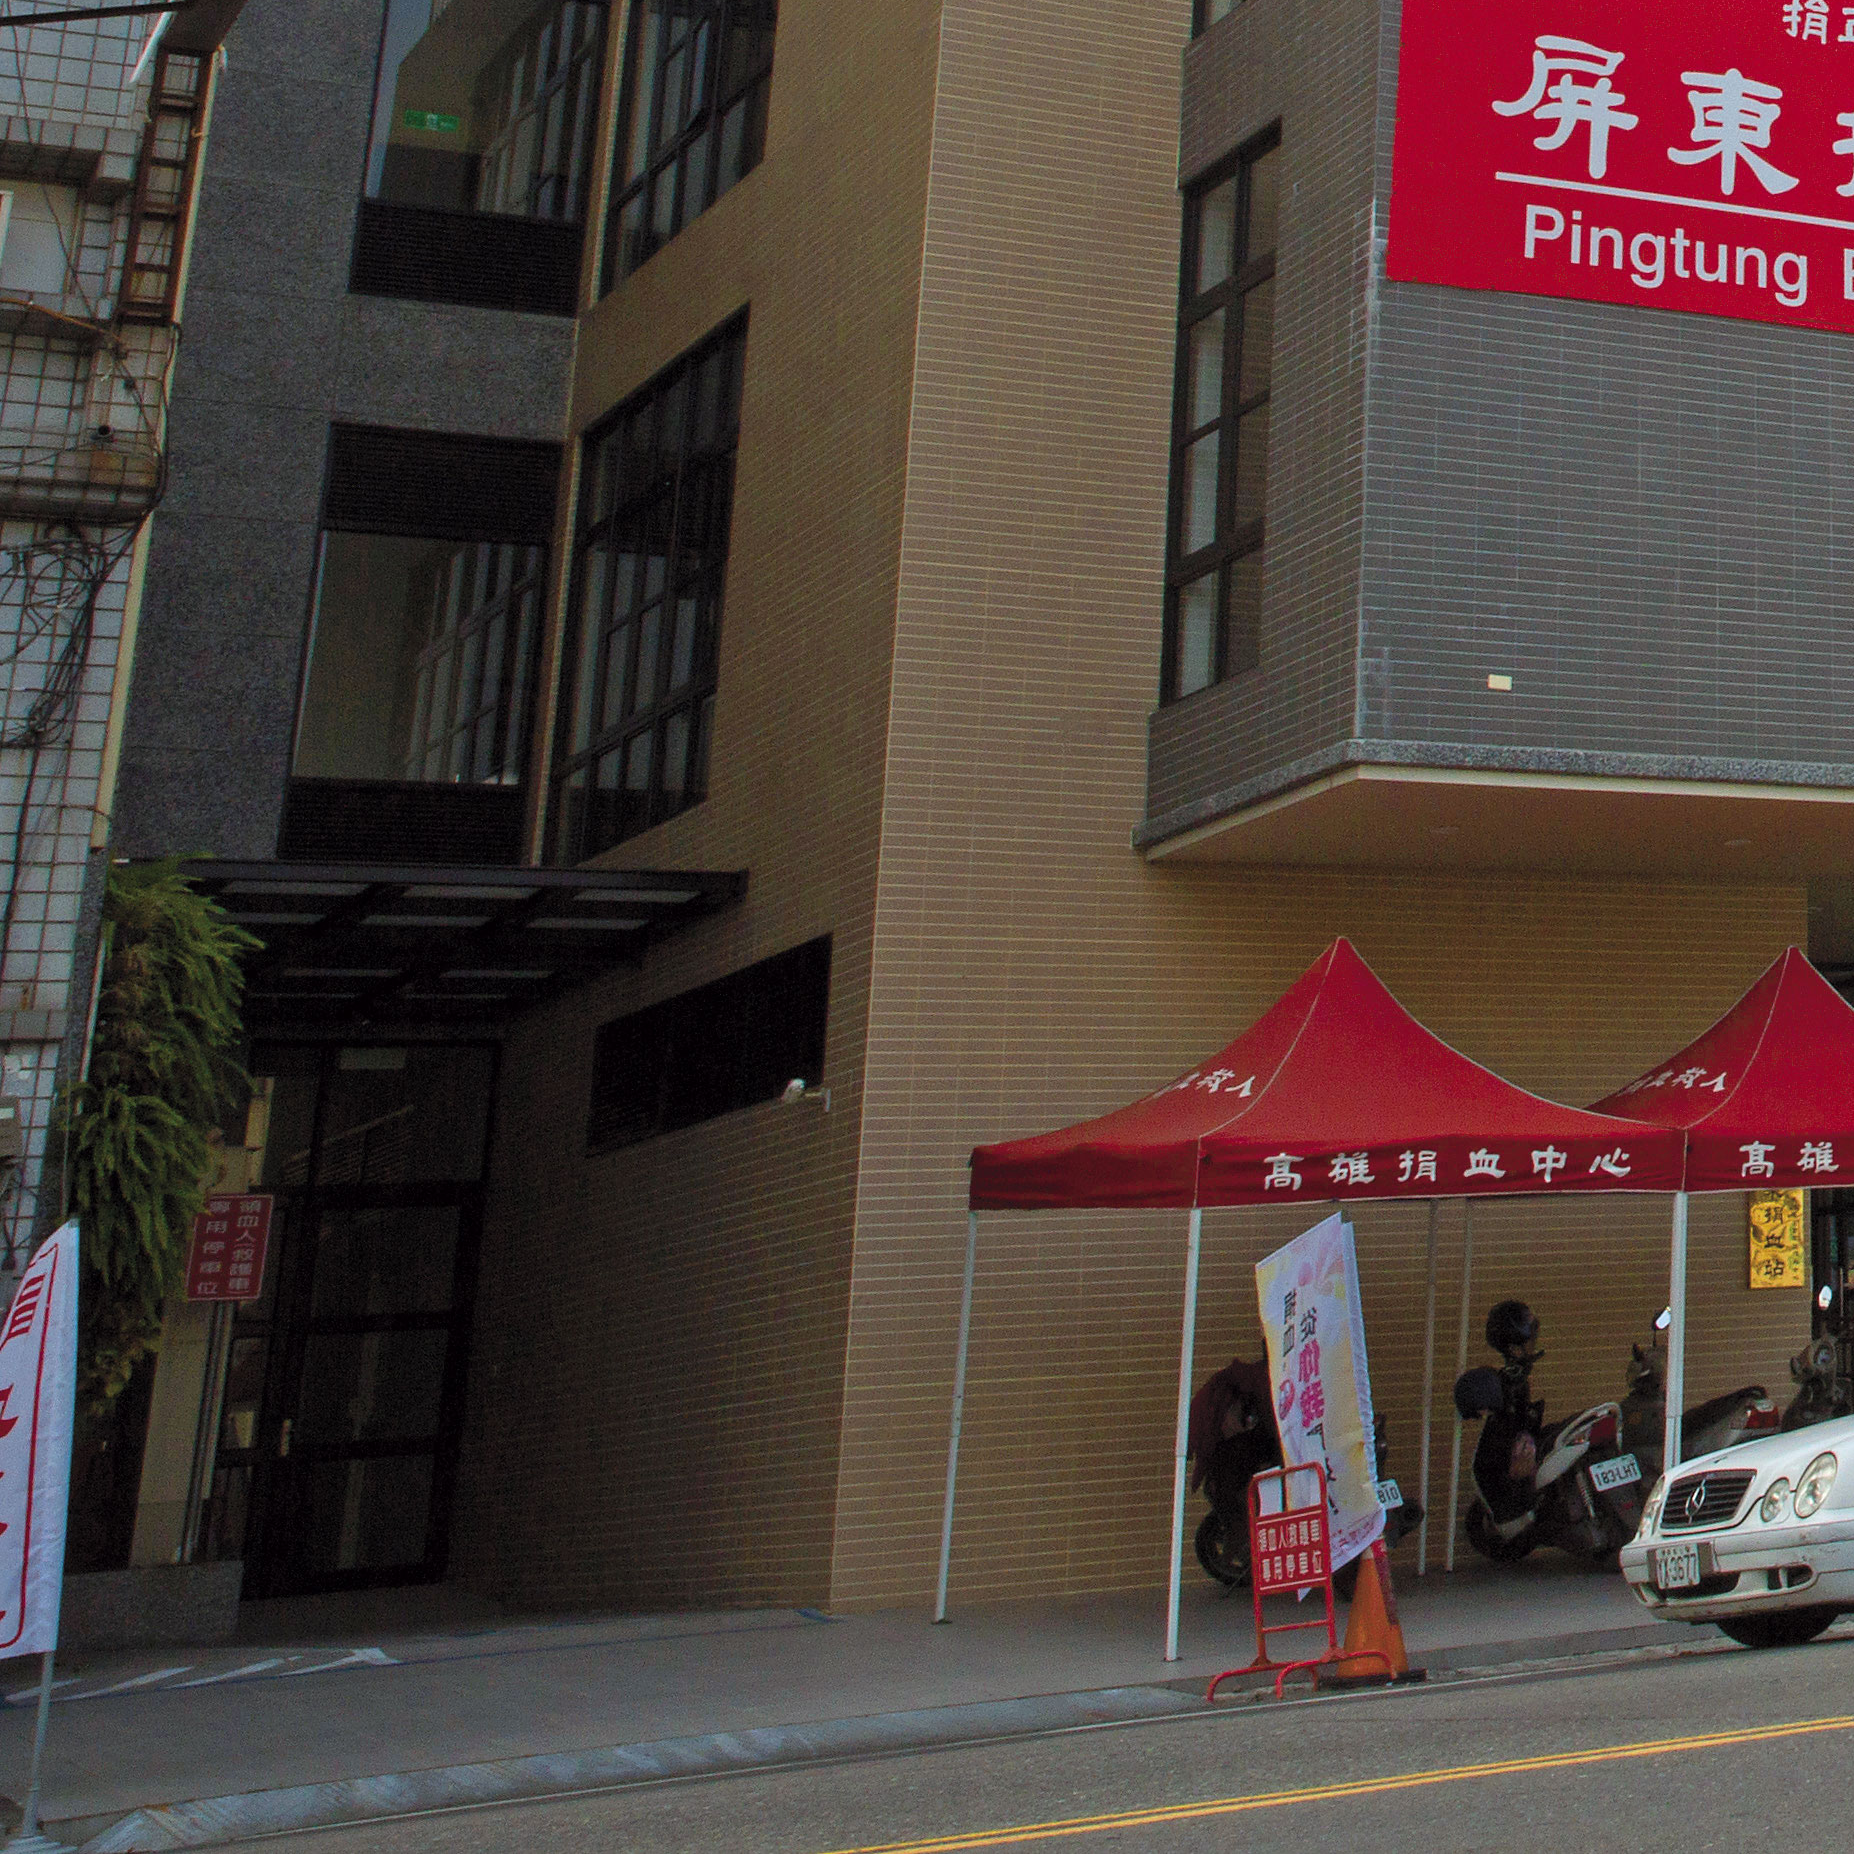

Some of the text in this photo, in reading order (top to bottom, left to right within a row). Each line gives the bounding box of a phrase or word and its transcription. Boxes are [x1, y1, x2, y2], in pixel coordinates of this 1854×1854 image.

[1524, 204, 1808, 307] Pingtung
[1264, 1147, 1632, 1191] 高雄捐血中心
